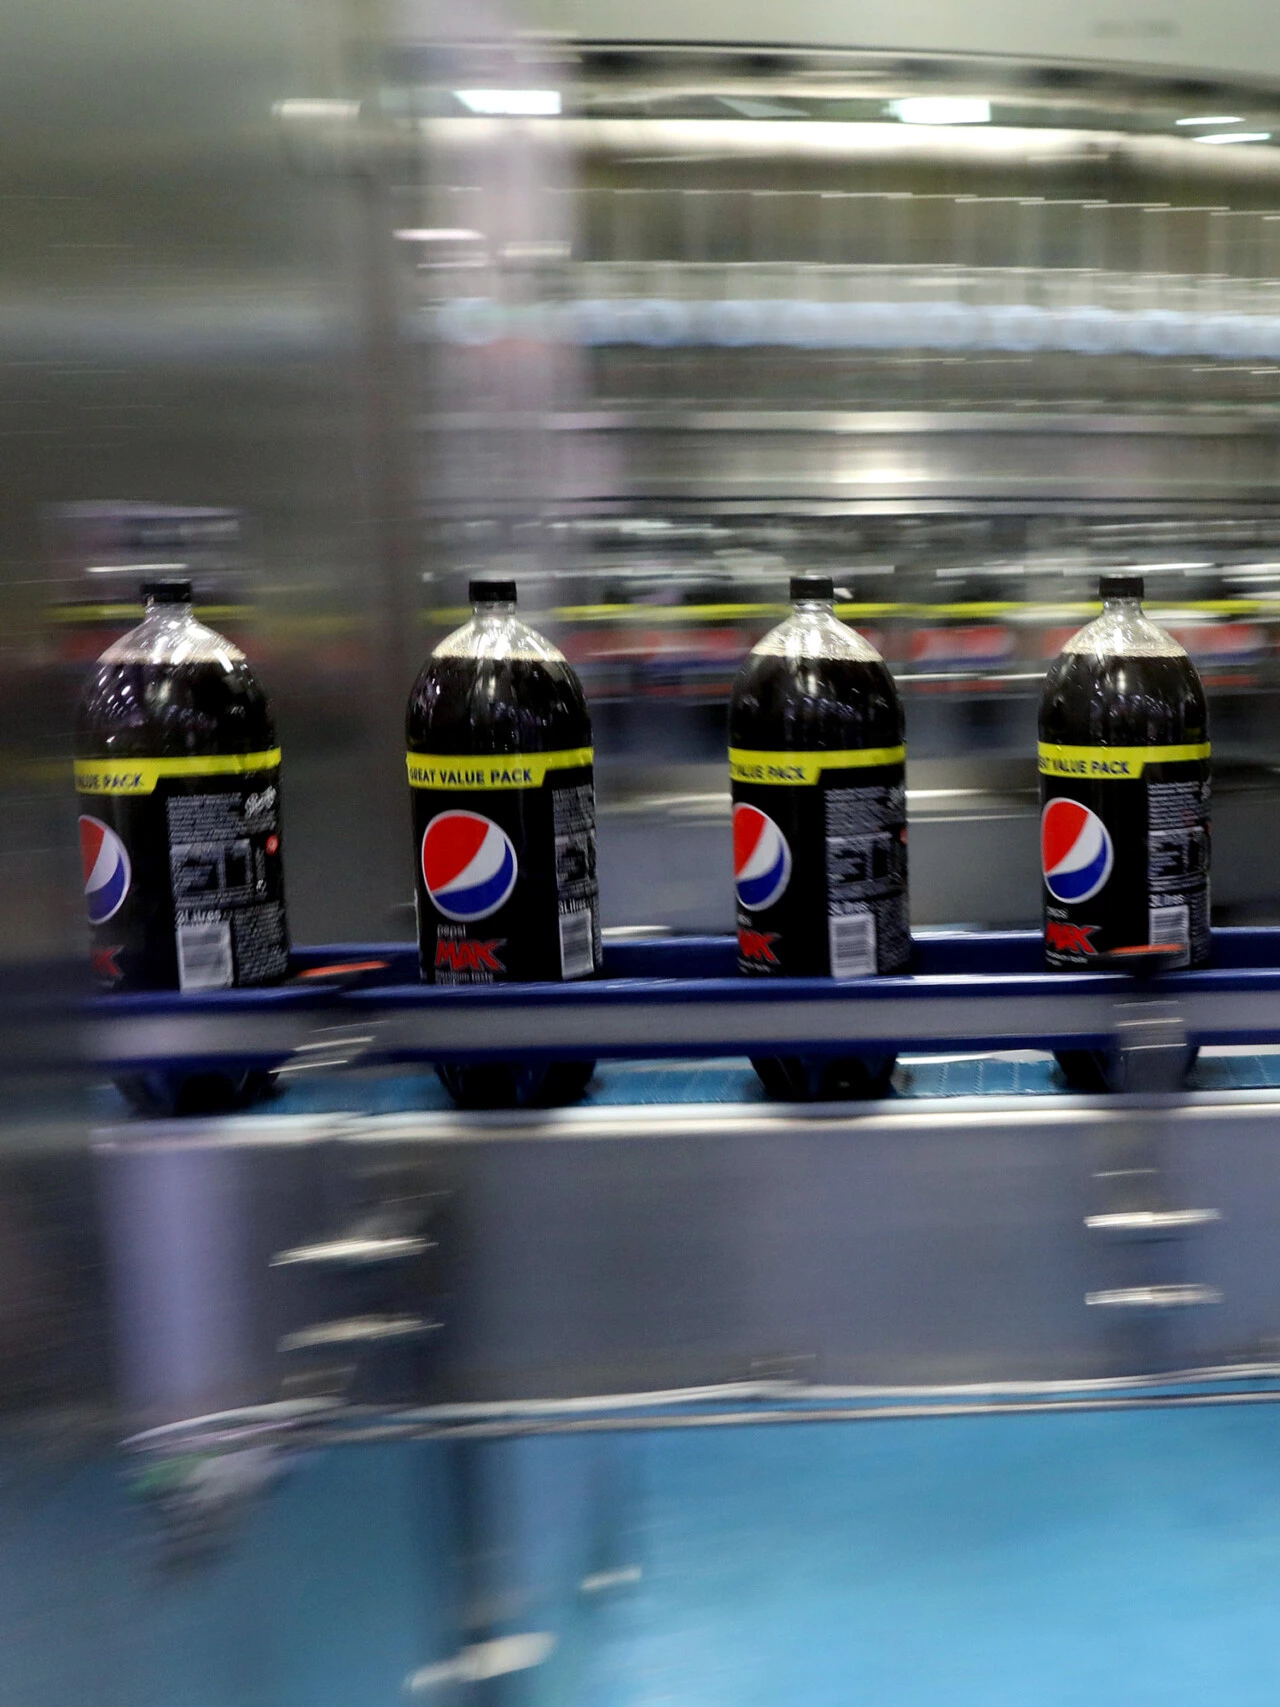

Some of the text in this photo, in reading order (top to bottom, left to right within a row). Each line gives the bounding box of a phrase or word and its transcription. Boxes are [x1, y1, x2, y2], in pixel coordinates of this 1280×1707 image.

[1091, 760, 1130, 775] PACK
[440, 769, 485, 785] VALUE
[491, 768, 532, 784] PACK
[435, 938, 508, 972] MAX
